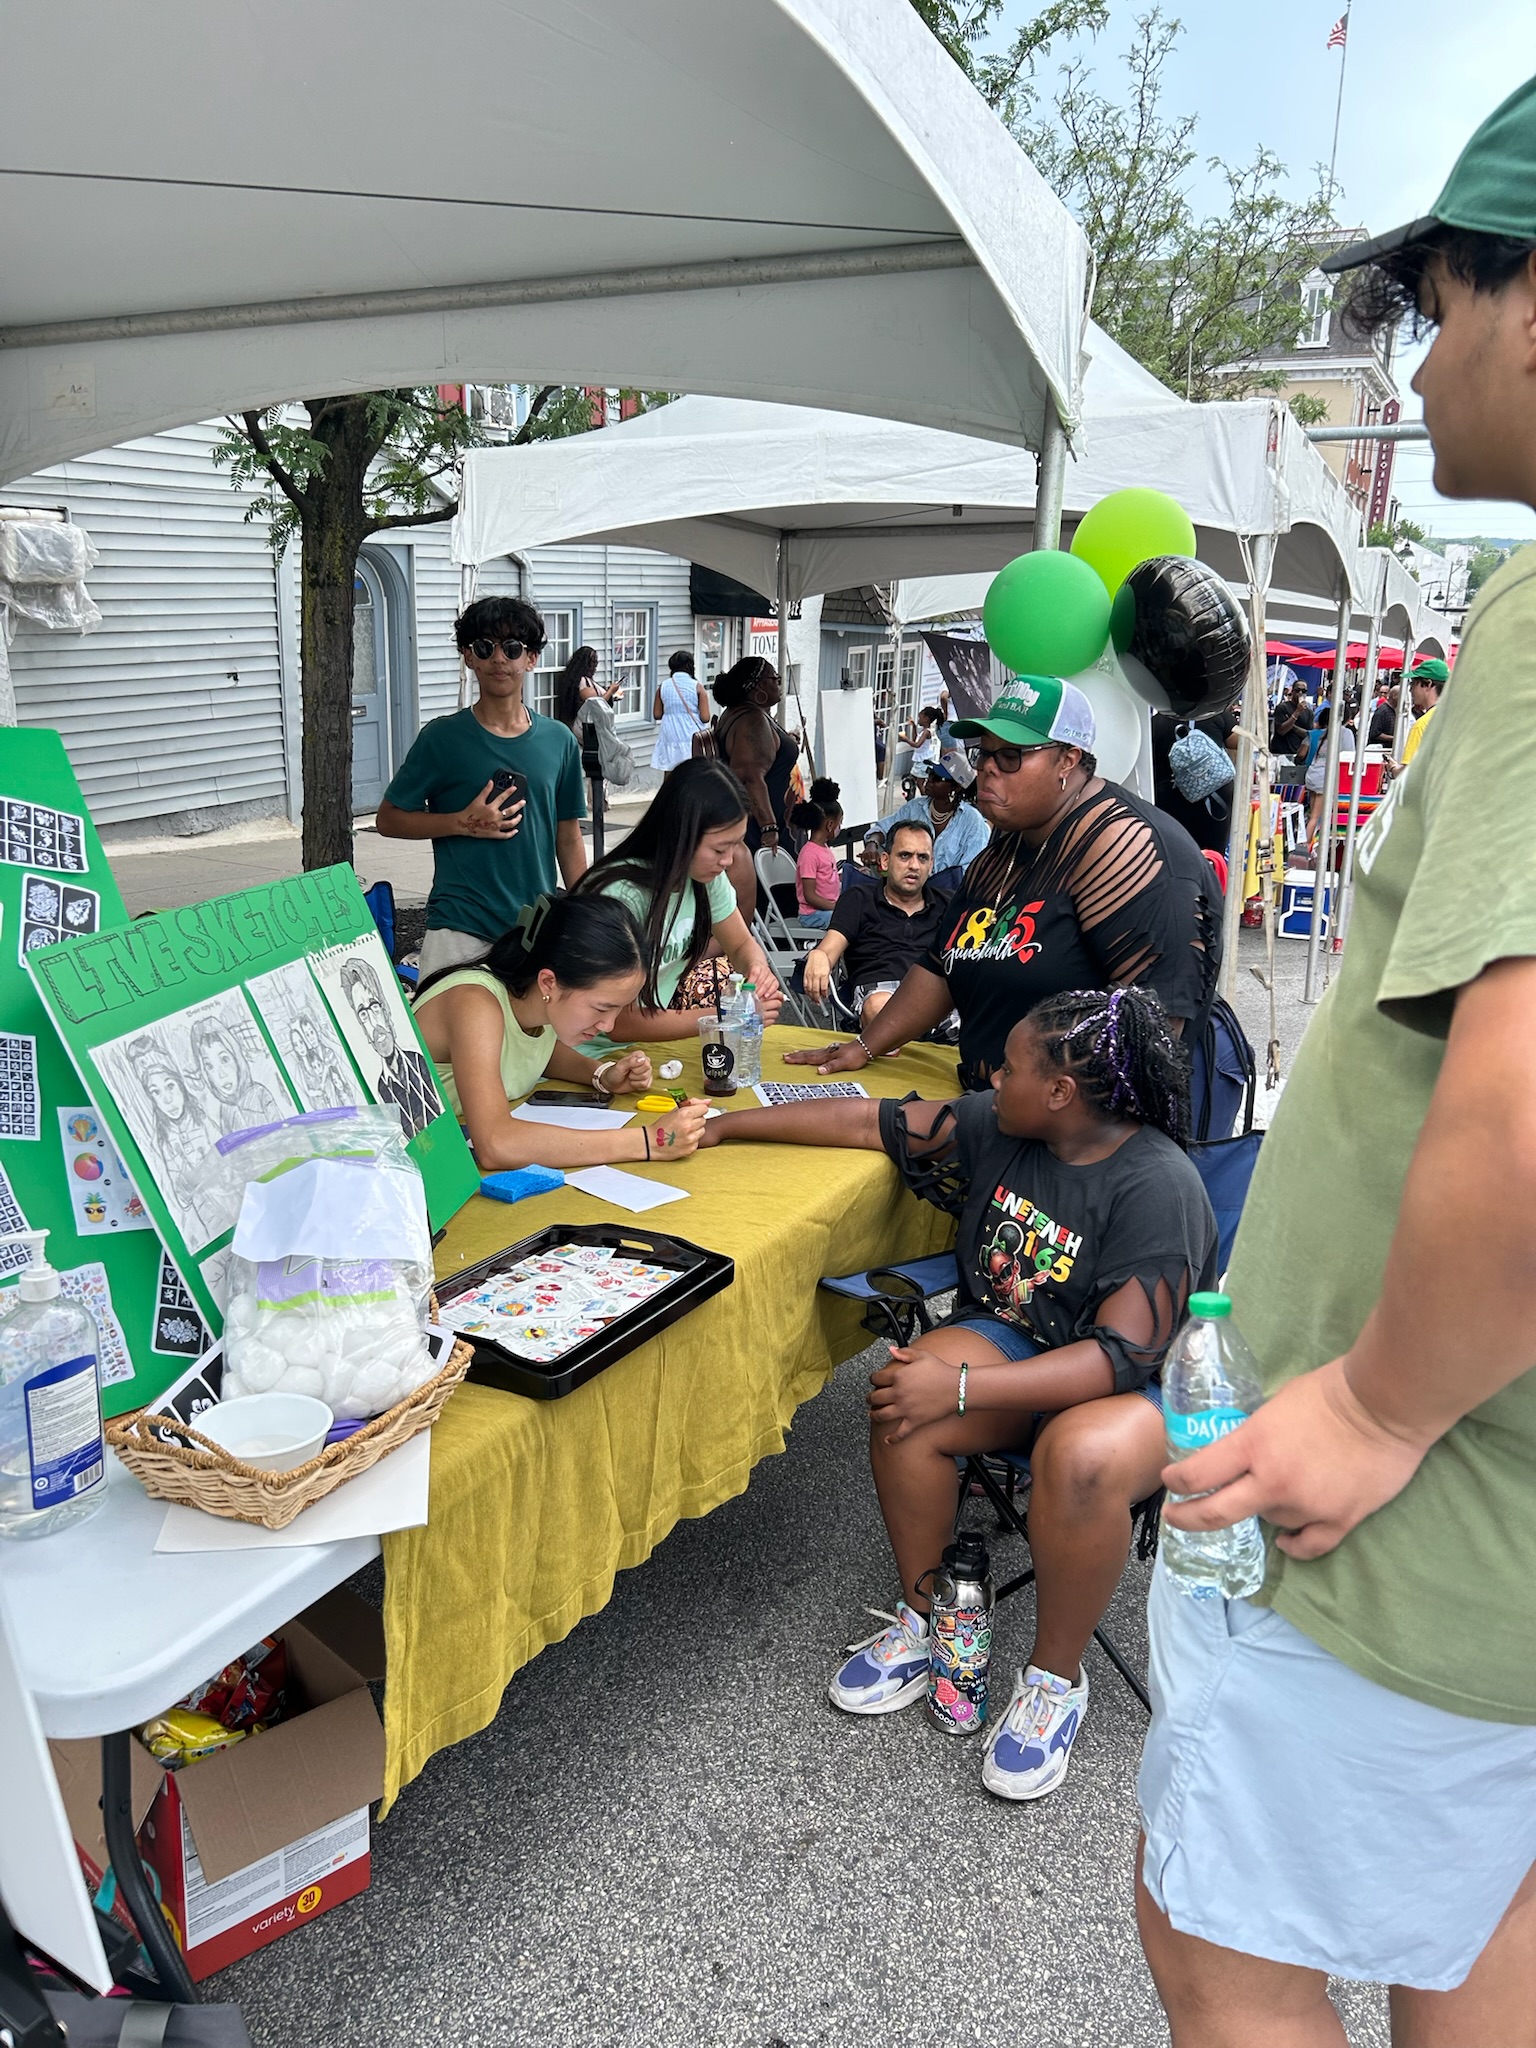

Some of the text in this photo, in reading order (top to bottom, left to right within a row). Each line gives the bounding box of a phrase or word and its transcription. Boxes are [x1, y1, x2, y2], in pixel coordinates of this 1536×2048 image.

[39, 864, 365, 1024] LIVE SKETCHES
[944, 900, 1045, 951] 1865
[252, 1903, 296, 1934] variety
[302, 1890, 316, 1907] 30
